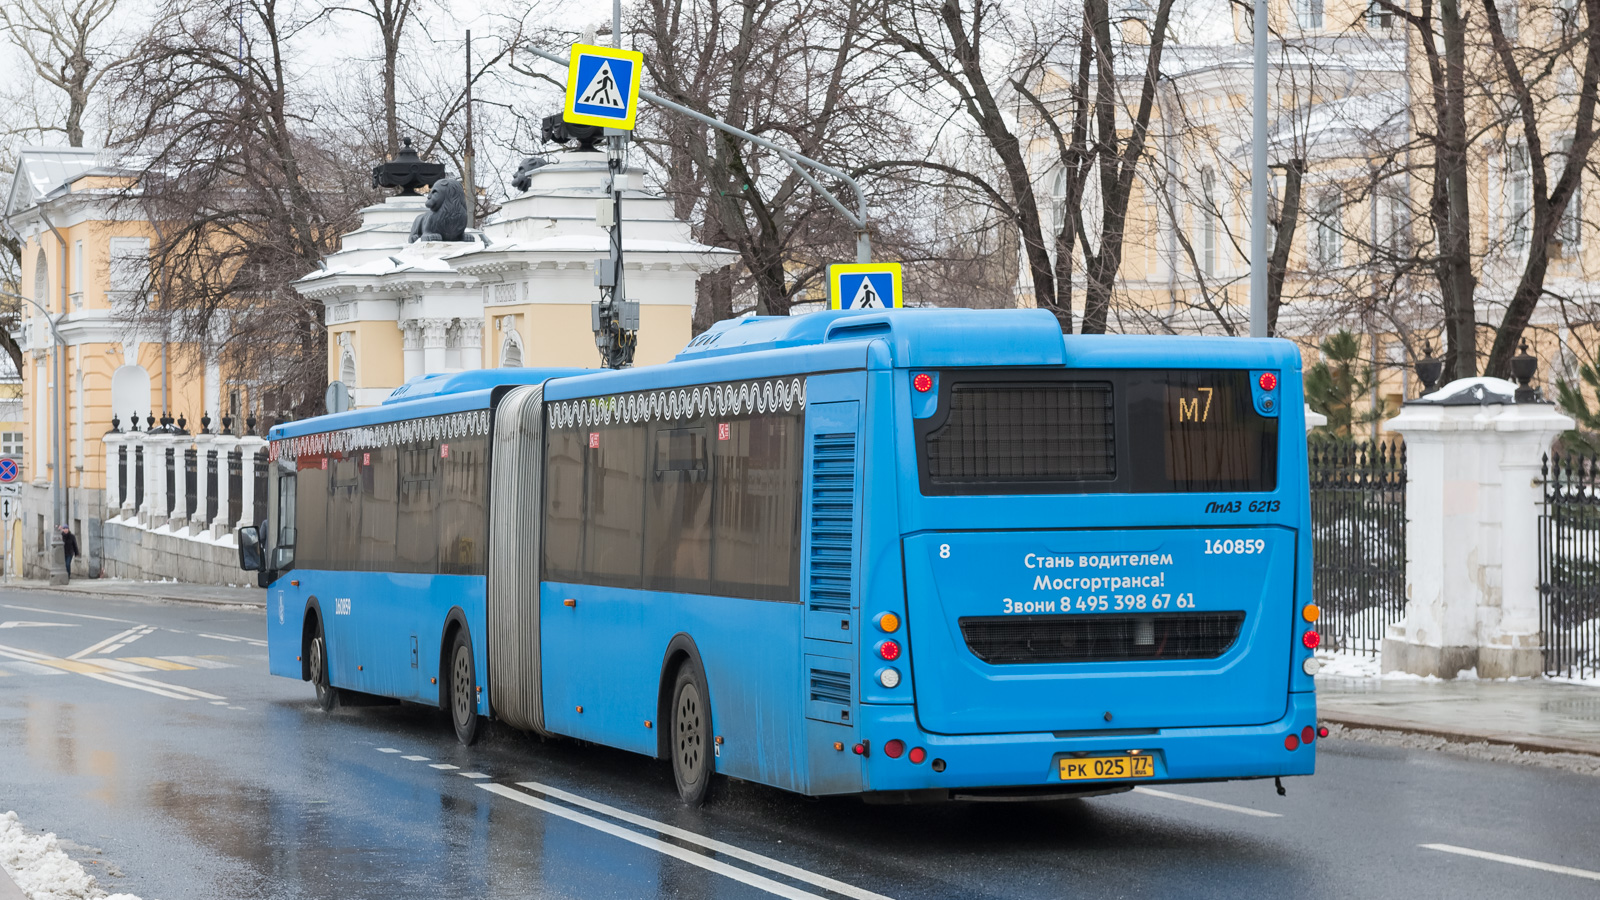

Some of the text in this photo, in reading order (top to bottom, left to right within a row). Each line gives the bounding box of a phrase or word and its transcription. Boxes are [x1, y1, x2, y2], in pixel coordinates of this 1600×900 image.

[1248, 500, 1281, 513] 6213
[938, 543, 951, 559] 8
[1204, 538, 1265, 555] 160859
[1024, 552, 1174, 571] Стань водителем
[1033, 572, 1165, 593] Мосгортранса!
[335, 597, 352, 616] 160859
[1002, 592, 1196, 614] Звони 8 495 398 67 61
[1094, 759, 1125, 776] 025
[1132, 757, 1148, 770] 77
